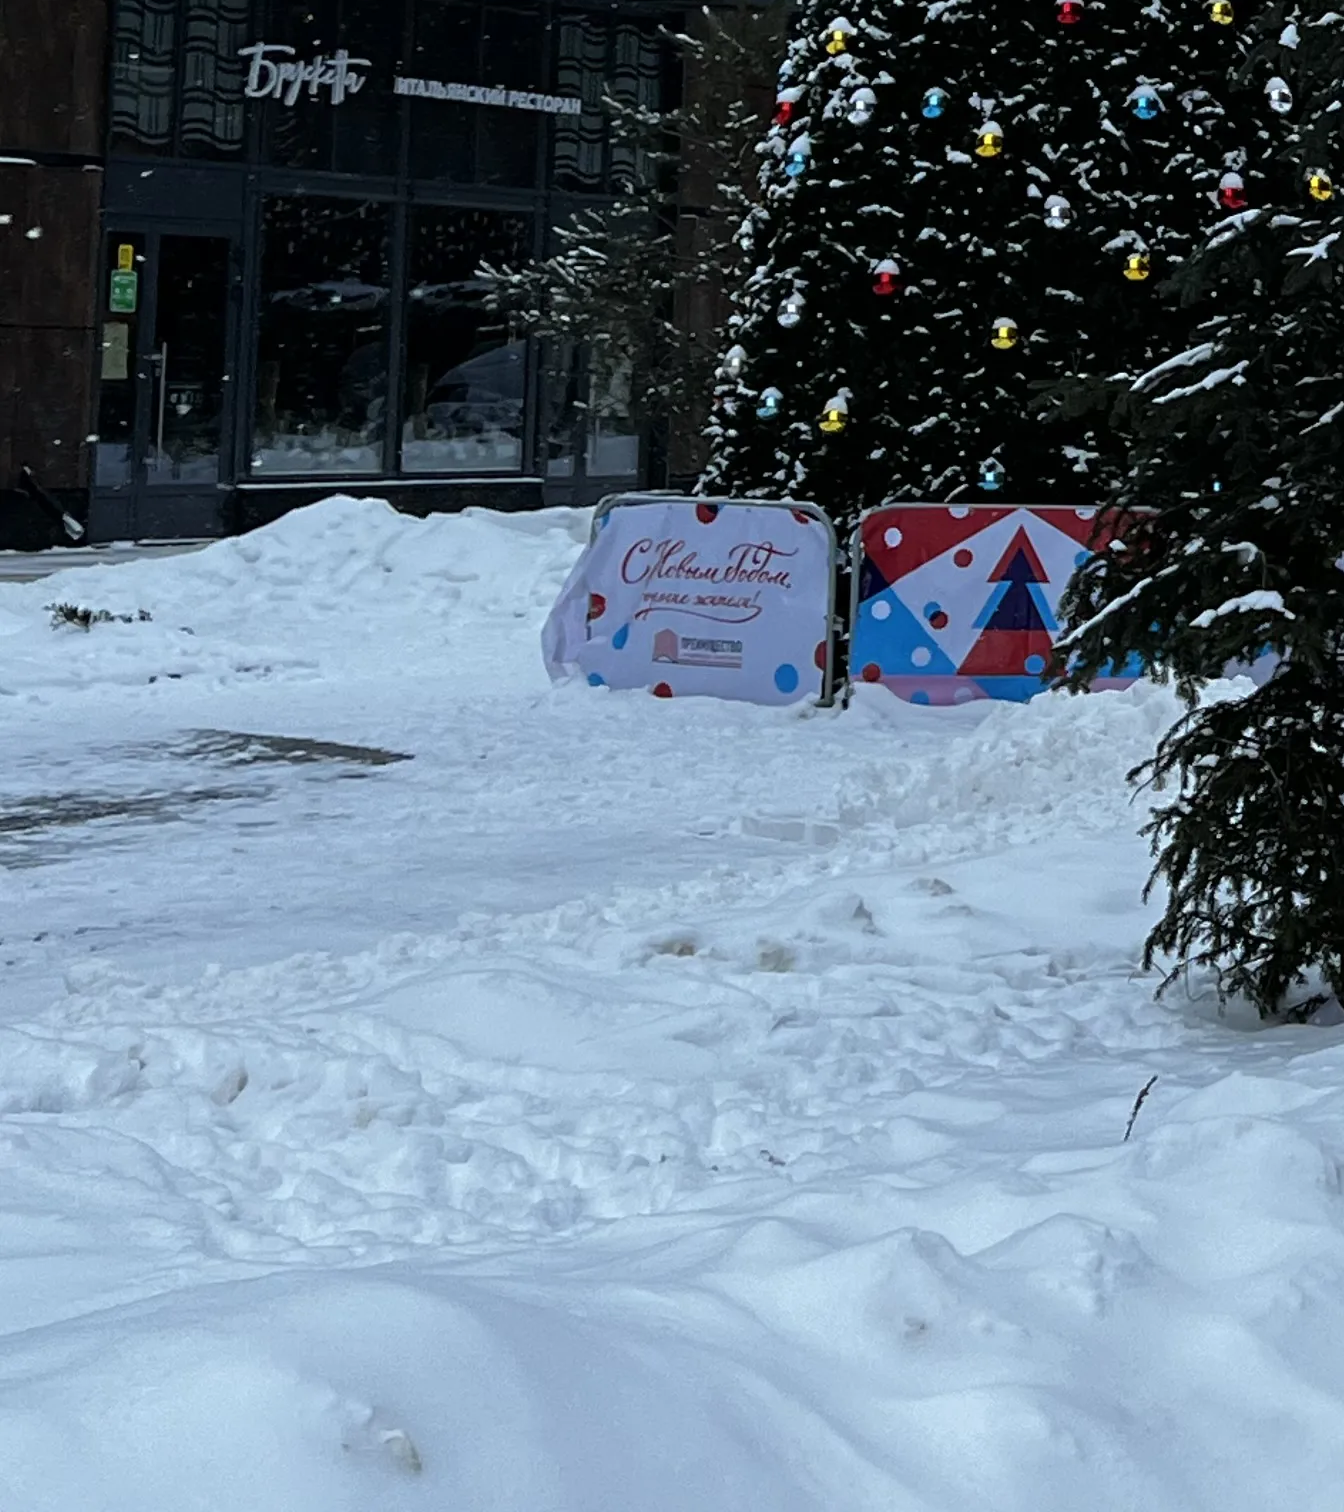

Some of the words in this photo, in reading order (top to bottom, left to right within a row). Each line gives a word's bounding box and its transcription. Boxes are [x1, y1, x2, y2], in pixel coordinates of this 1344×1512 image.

[393, 76, 506, 106] ИТАЛЬЯНСКИЙ
[508, 90, 581, 114] РЕСТОРАН
[621, 538, 652, 584] С
[648, 539, 718, 584] Новым
